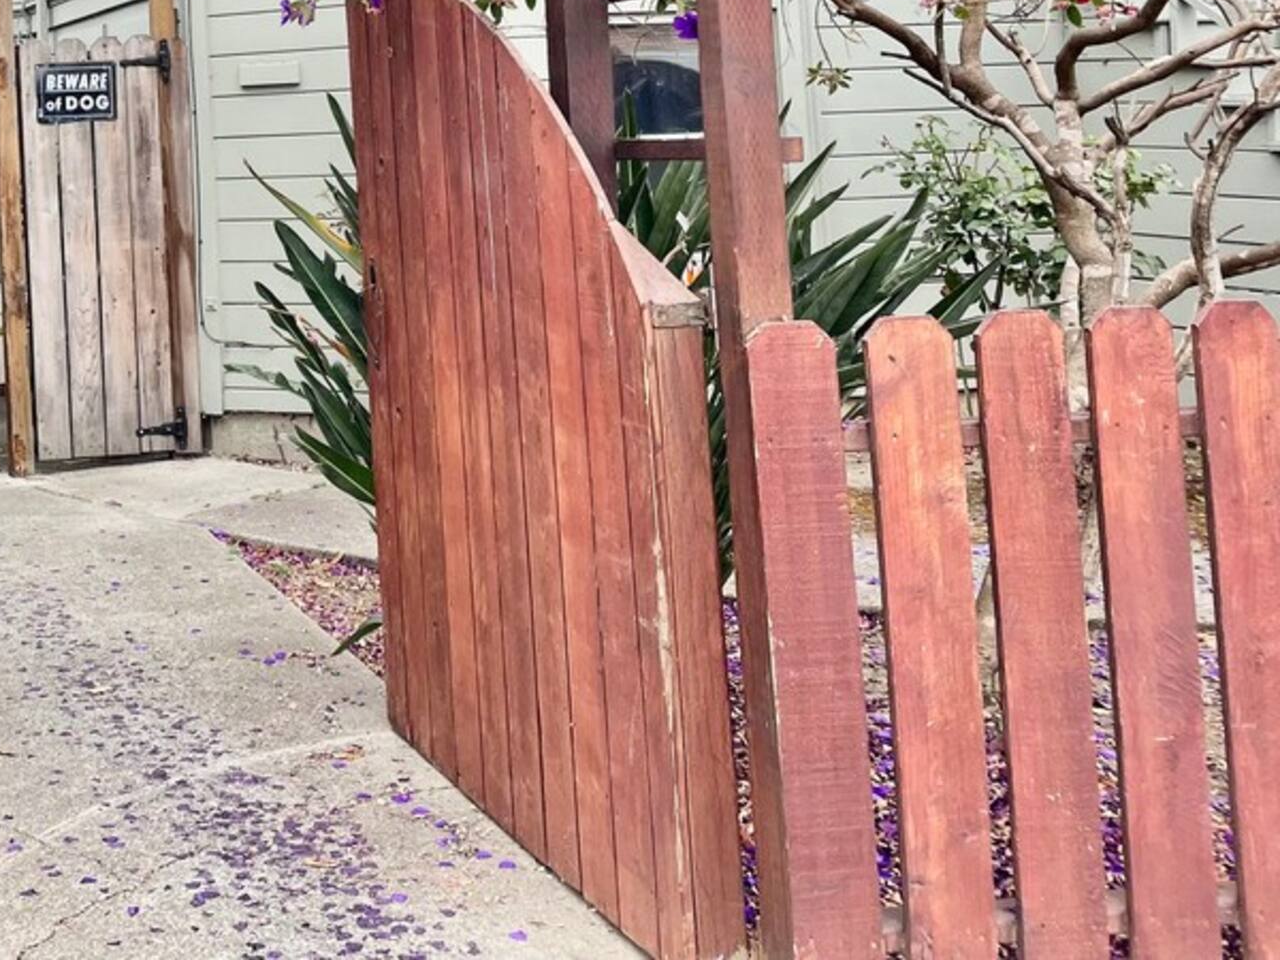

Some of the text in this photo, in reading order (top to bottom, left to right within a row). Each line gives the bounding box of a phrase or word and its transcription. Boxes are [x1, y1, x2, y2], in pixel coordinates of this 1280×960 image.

[46, 72, 108, 91] BEWARE
[46, 94, 109, 112] of DOG
